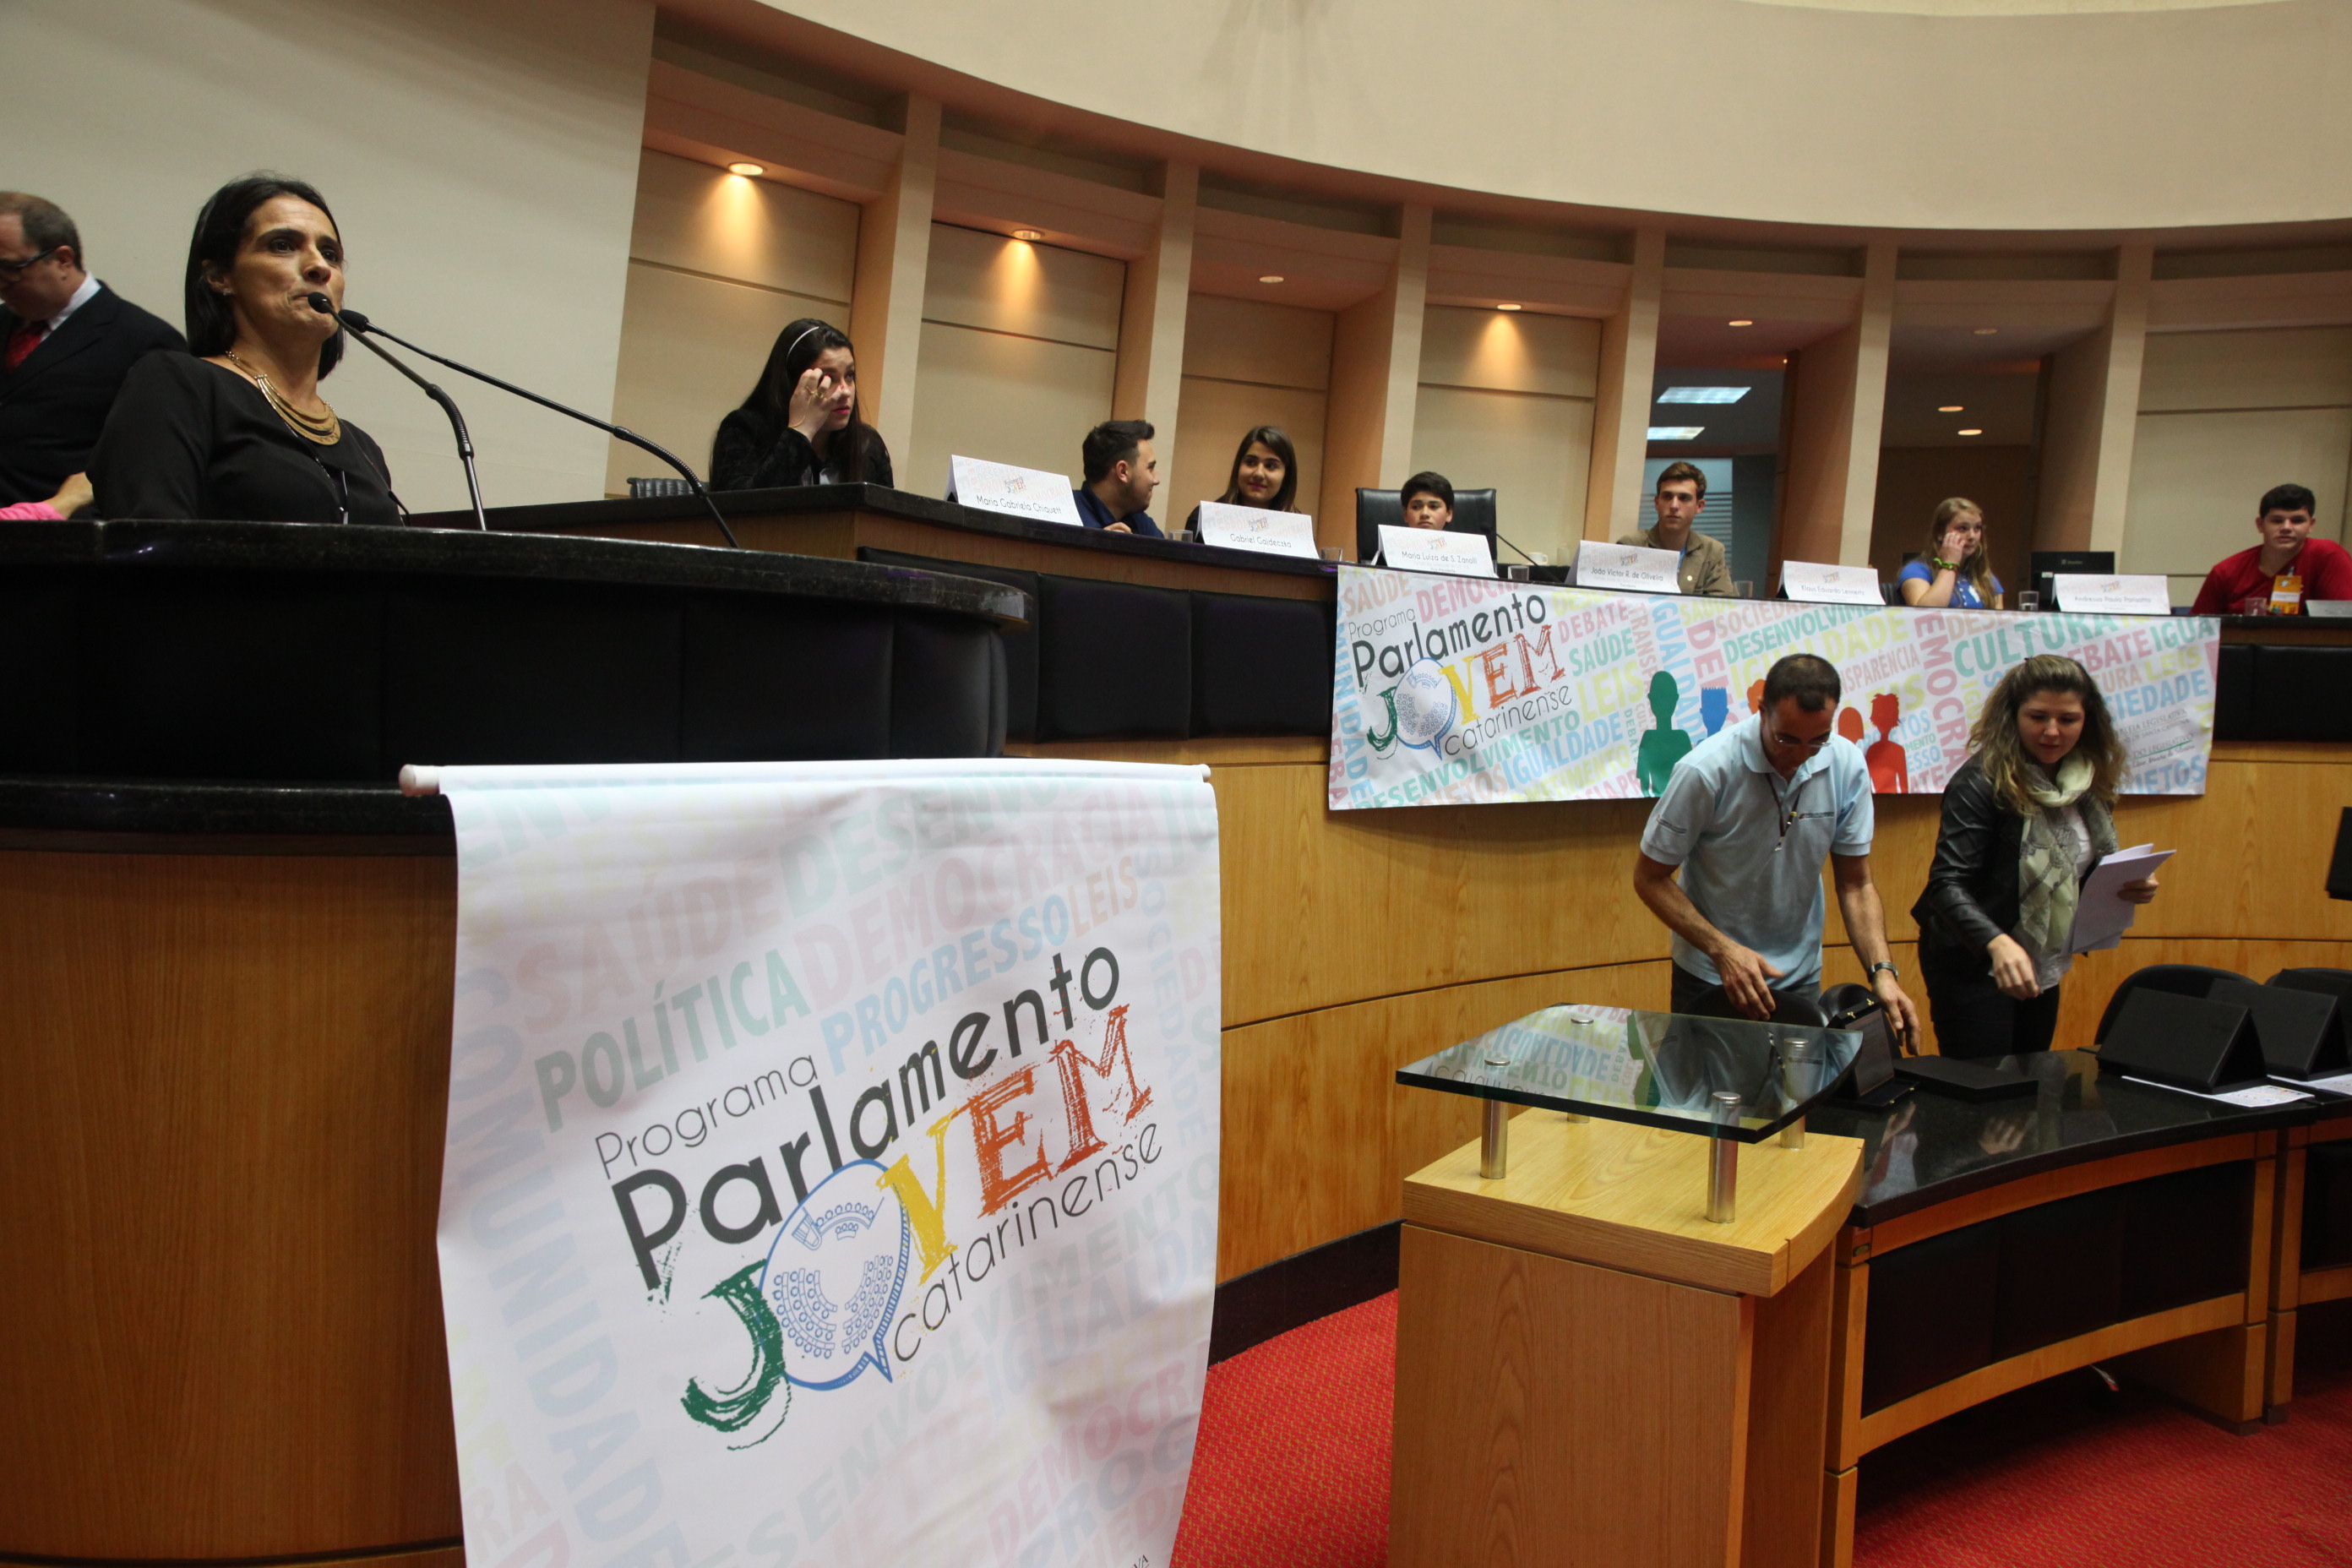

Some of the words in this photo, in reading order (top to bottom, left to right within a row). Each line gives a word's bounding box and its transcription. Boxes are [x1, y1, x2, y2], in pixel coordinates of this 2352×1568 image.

[977, 495, 999, 506] Maria
[1000, 498, 1032, 511] Gabriela
[1230, 533, 1255, 543] Gabriel
[1402, 551, 1420, 559] Maria
[1422, 553, 1439, 561] Luiza
[1592, 567, 1605, 575] João
[1607, 569, 1624, 577] Victor
[1641, 572, 1663, 581] Oliveira
[1348, 608, 1415, 640] Programa
[1353, 593, 1546, 690] Parlamento
[1558, 599, 1631, 644] DEBATE
[1569, 628, 1636, 677] SAÚDE
[2067, 629, 2153, 672] EBATE
[1577, 660, 1643, 723] LEIS
[2144, 645, 2203, 682] LEIS
[1444, 685, 1572, 756] catarinense
[1502, 712, 1624, 790] IGUALDADE
[794, 781, 1158, 1012] DEMOCRACIA
[1068, 855, 1139, 939] LEIS
[515, 847, 782, 1036] SAÚDE
[820, 894, 1069, 1076] PROGRESSO
[534, 949, 812, 1133] POLÍTICA
[594, 1054, 819, 1181] Programa
[610, 946, 1120, 1296] Parlamento
[893, 1122, 1162, 1363] catarinense
